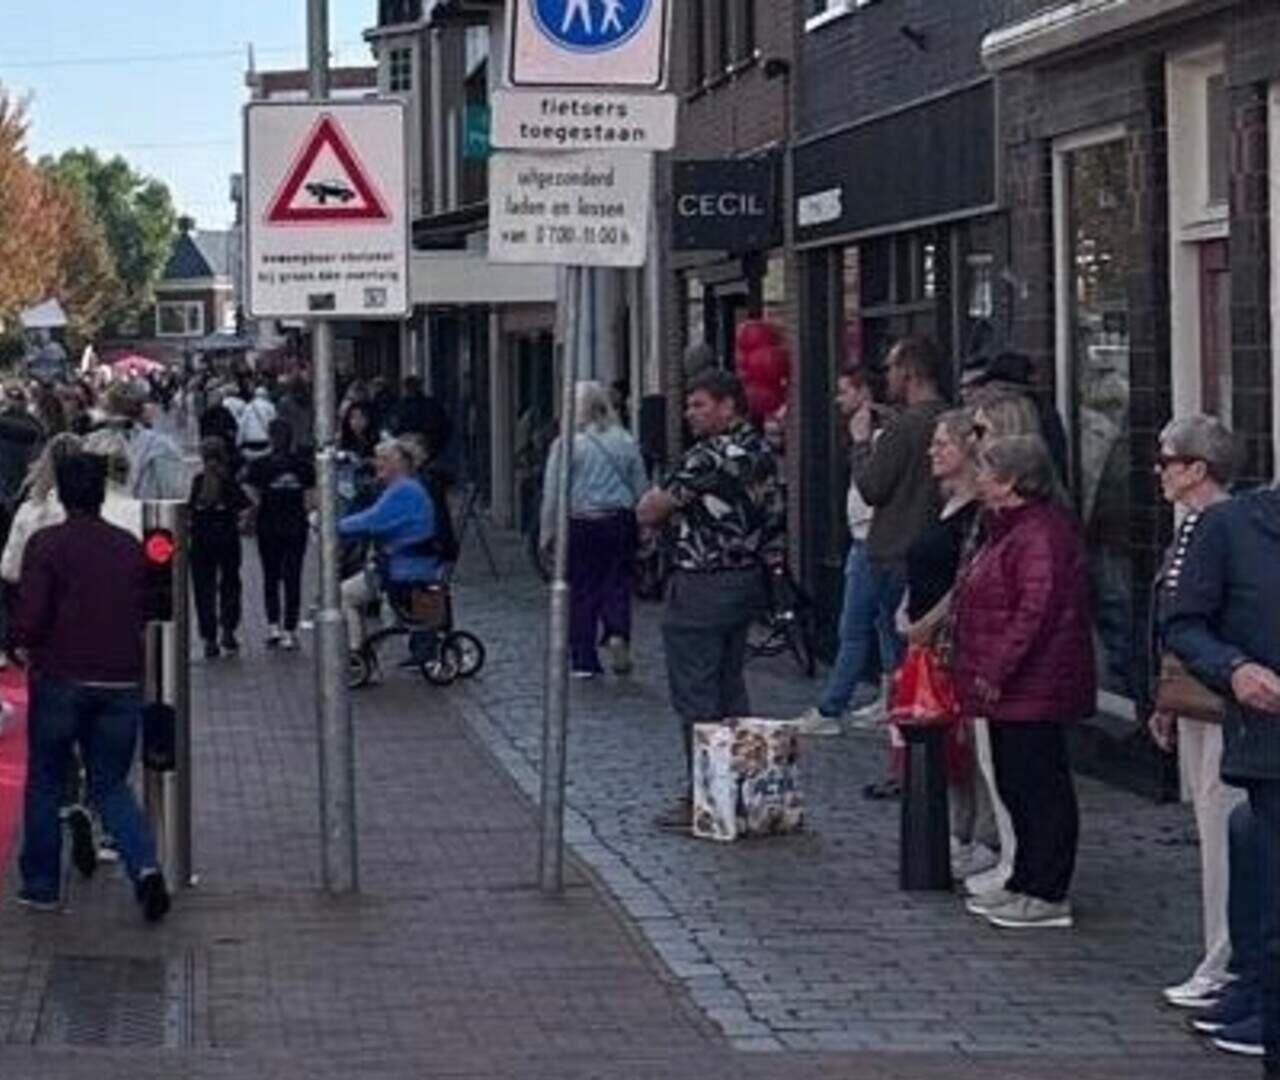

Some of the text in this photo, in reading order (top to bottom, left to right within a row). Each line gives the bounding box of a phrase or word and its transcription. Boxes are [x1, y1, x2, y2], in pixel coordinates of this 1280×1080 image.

[540, 98, 629, 118] fietsers
[519, 123, 645, 144] toegestaan
[517, 166, 615, 190] uitgezonderd
[505, 194, 625, 217] laden en lossen
[676, 191, 765, 217] CECIL
